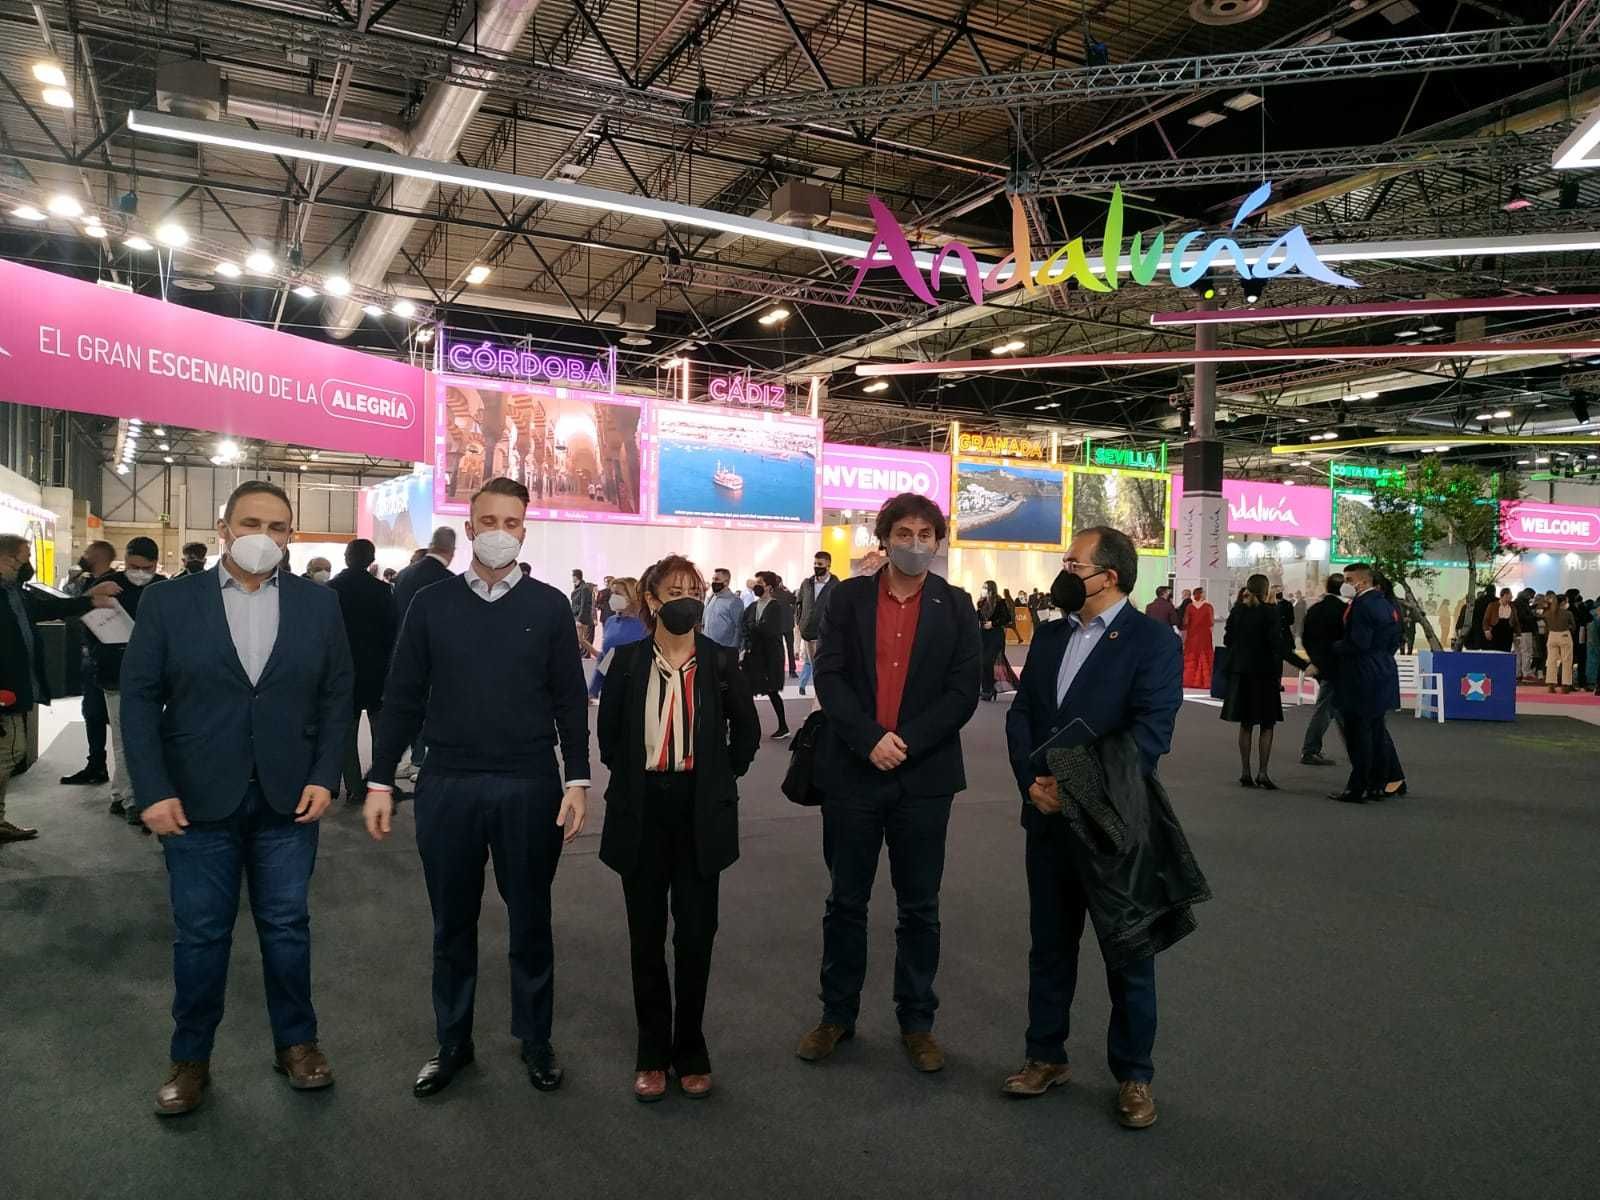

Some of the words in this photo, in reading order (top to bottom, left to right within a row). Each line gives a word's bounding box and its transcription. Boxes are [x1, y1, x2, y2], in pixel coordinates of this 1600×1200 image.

[842, 182, 1362, 307] Andalucía
[38, 324, 71, 358] EL
[77, 334, 141, 371] GRAN
[148, 348, 264, 394] ESCENARIO
[268, 374, 293, 400] DE
[296, 380, 318, 405] LA
[331, 389, 409, 420] ALEGRÍA
[449, 340, 607, 386] CÓRDOBA
[709, 375, 785, 408] CÁDIZ
[958, 430, 1043, 458] GRANADA
[1094, 447, 1157, 468] SEVILLA
[821, 464, 930, 494] NVENIDO
[1520, 516, 1591, 537] WELCOME
